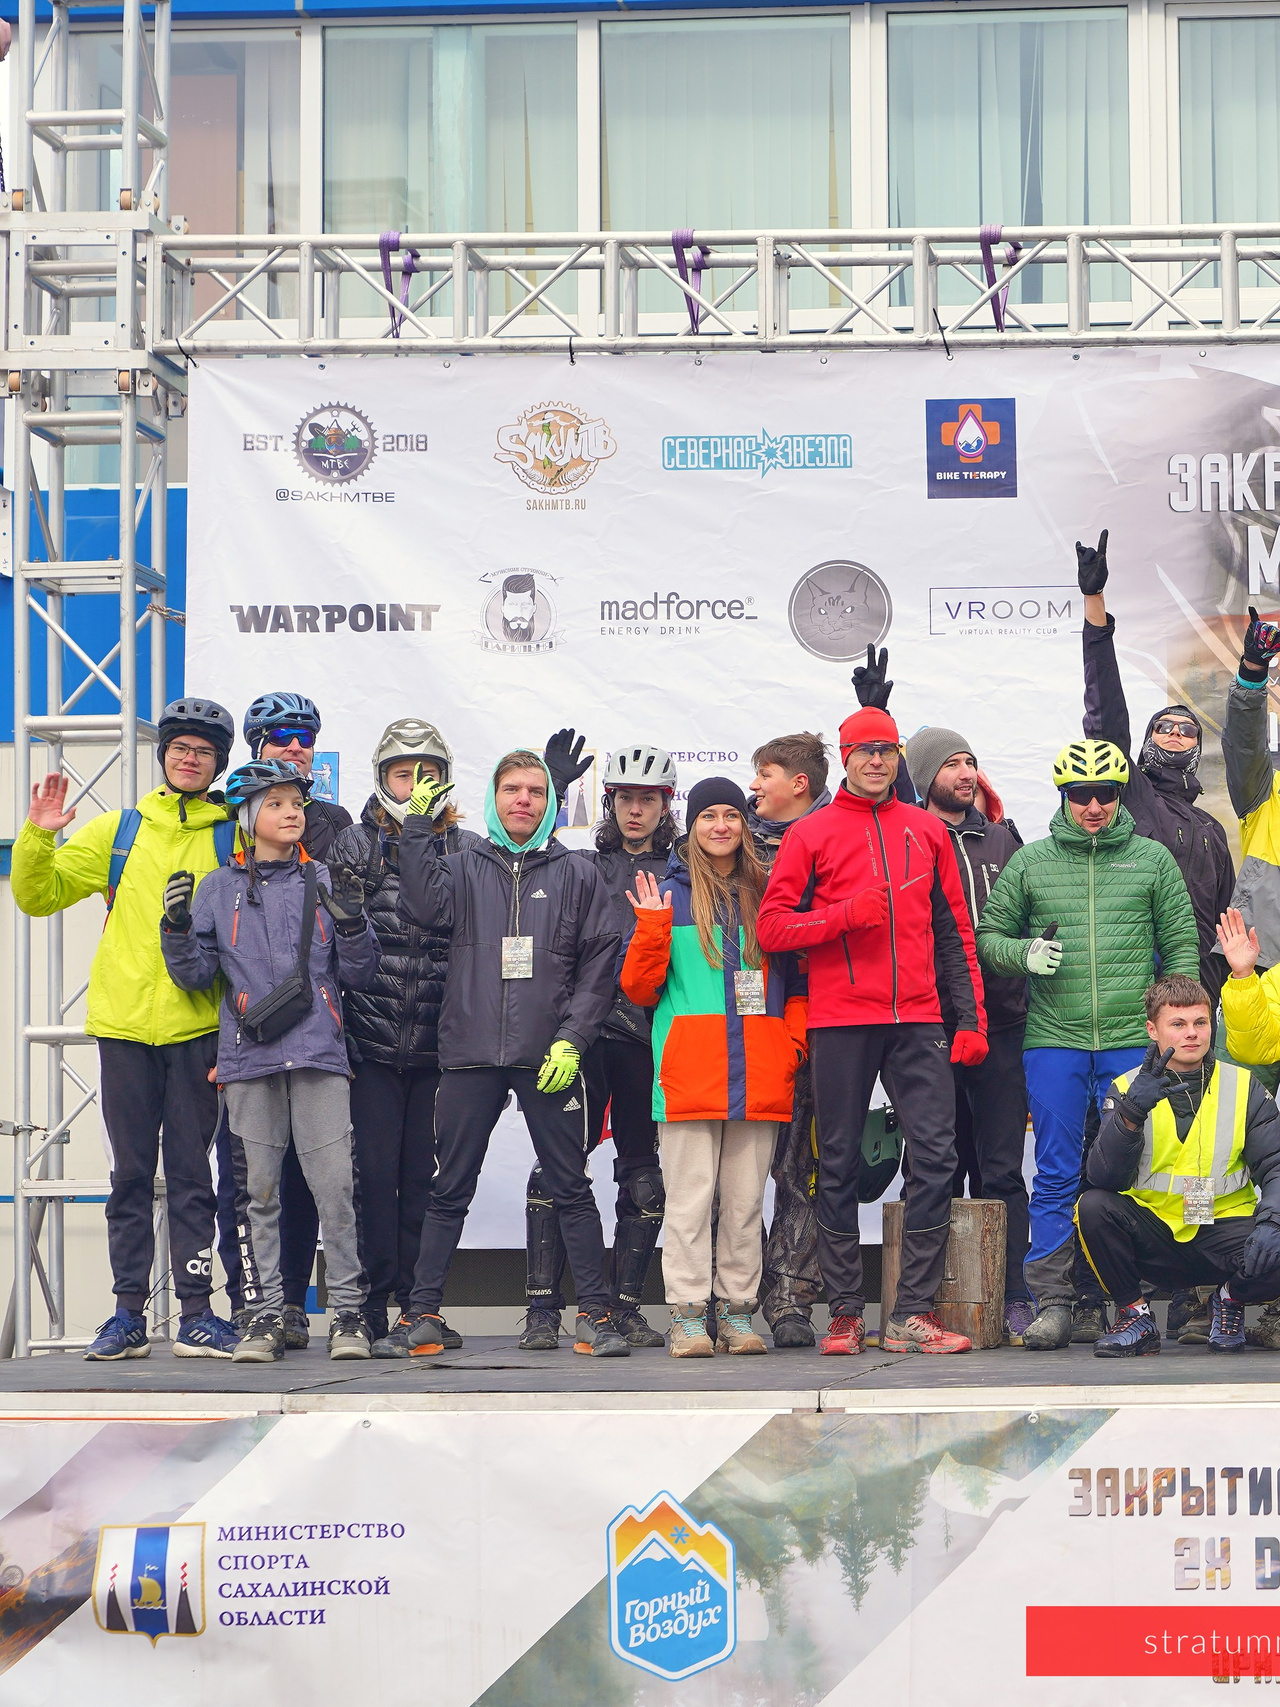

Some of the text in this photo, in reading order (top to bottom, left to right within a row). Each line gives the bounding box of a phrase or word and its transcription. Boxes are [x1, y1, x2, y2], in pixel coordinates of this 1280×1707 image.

[243, 433, 428, 452] EST. 2018
[664, 434, 852, 468] СЕВЕРНАЯ ЗВЕЗДА
[936, 472, 960, 481] BIKE
[275, 488, 395, 503] @SAKHMTBE
[526, 498, 587, 511] SAKHMTB.RU
[230, 603, 441, 633] WARPOINT
[945, 600, 1073, 620] VROOM
[600, 626, 700, 636] ENERGY DRINK
[217, 1523, 406, 1542] МИНИСТЕРСТВО
[217, 1553, 310, 1571] СПОРТА
[217, 1575, 391, 1599] САХАЛИНСКОЙ
[625, 1582, 711, 1624] Горный
[218, 1608, 327, 1627] ОБЛАСТИ
[628, 1602, 723, 1648] Воздух
